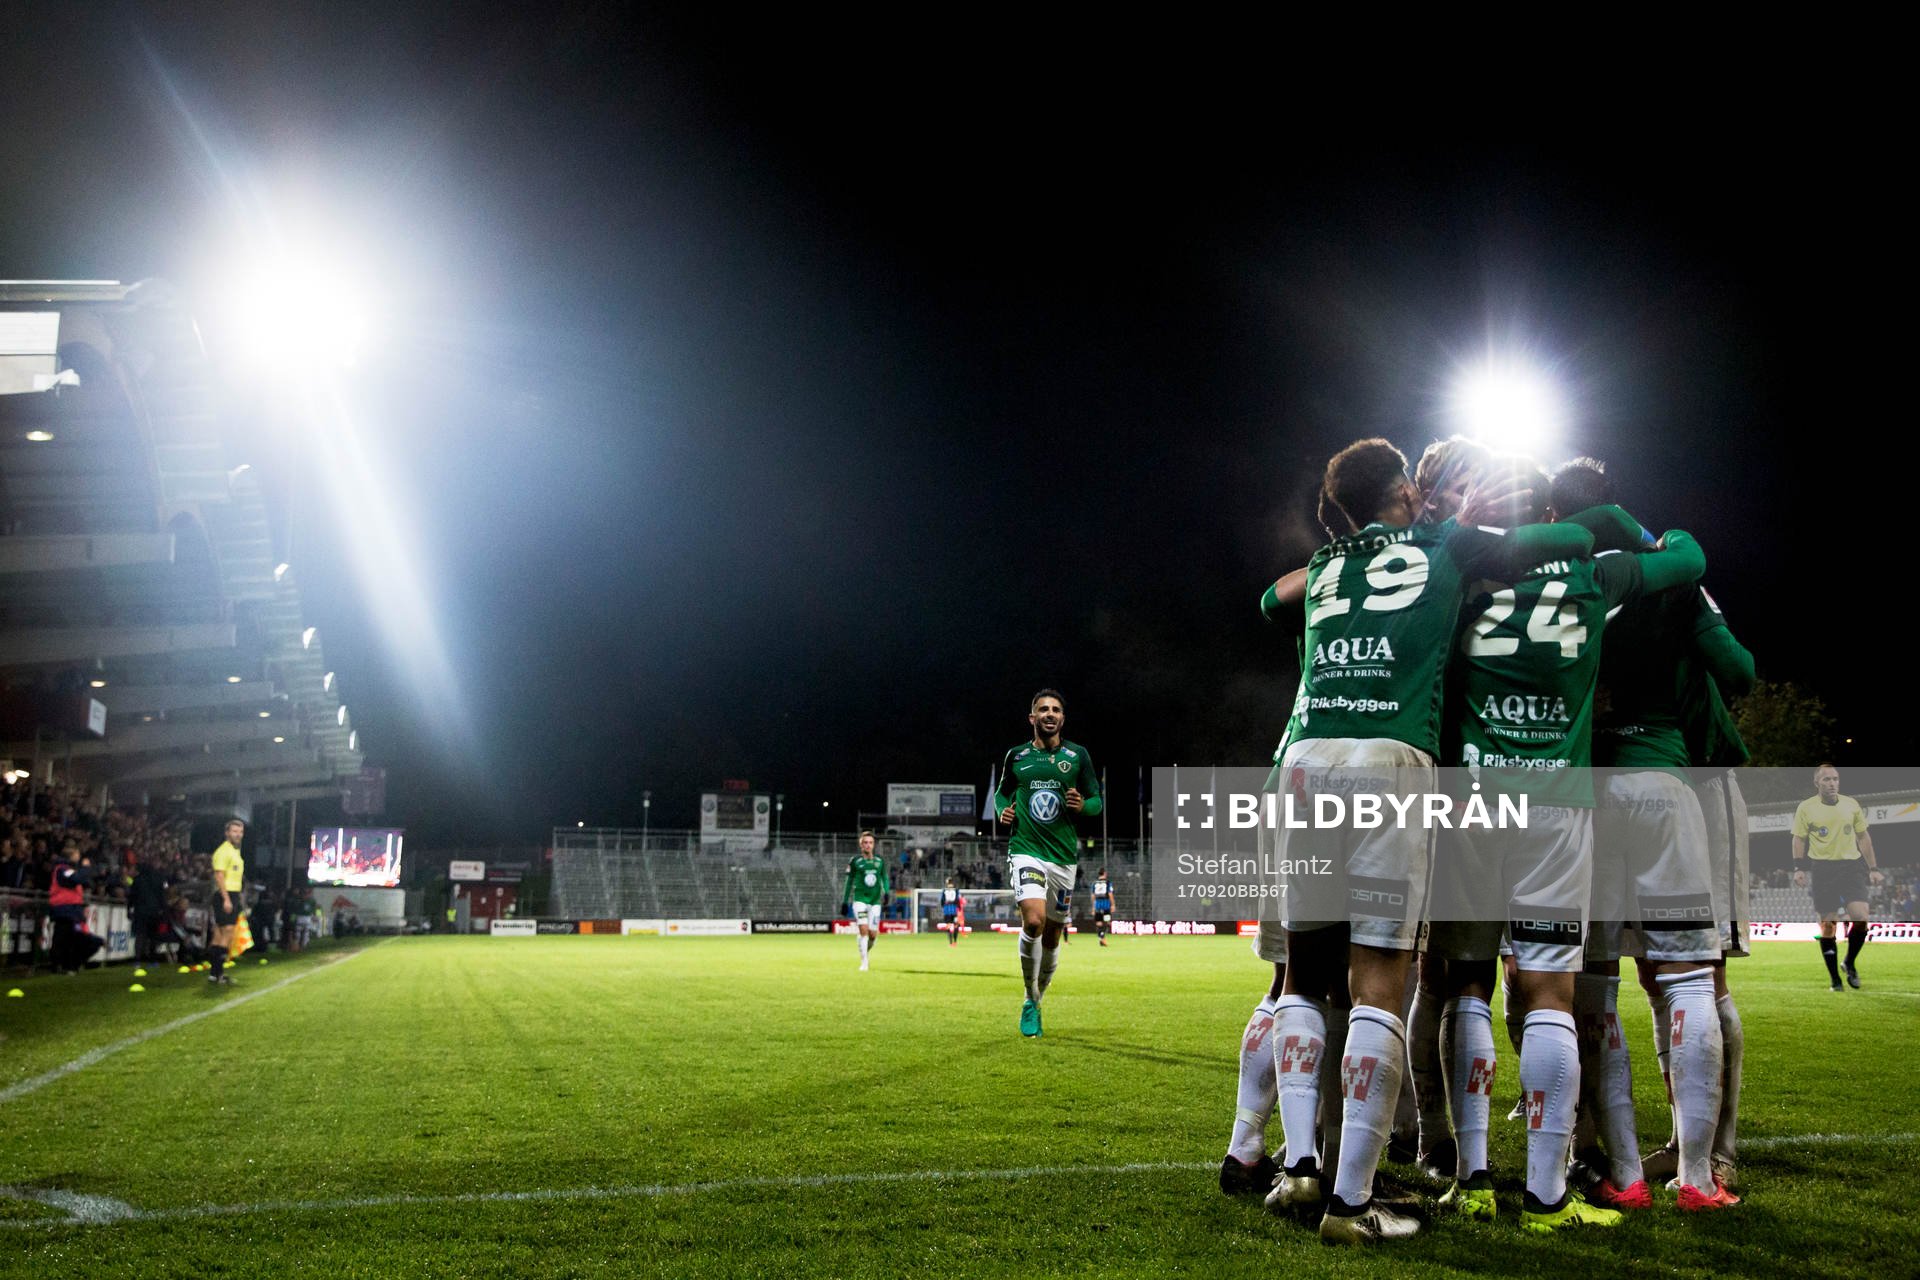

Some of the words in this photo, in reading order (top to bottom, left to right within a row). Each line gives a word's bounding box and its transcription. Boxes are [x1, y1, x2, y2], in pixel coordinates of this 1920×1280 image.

[1308, 542, 1430, 628] 19
[1464, 580, 1588, 659] 24
[1311, 636, 1396, 667] AQUA
[1312, 671, 1344, 684] DINNER
[1353, 669, 1392, 679] DRINKS
[1310, 695, 1400, 712] Riksbyggen
[1479, 694, 1570, 725] AQUA
[1484, 727, 1520, 738] DINNER
[1530, 731, 1568, 740] DRINKS
[1310, 774, 1394, 791] Riksbygge
[1876, 809, 1888, 820] EY
[1643, 905, 1710, 919] TOSITO
[1192, 920, 1215, 934] hem
[1512, 917, 1580, 934] TOSITO
